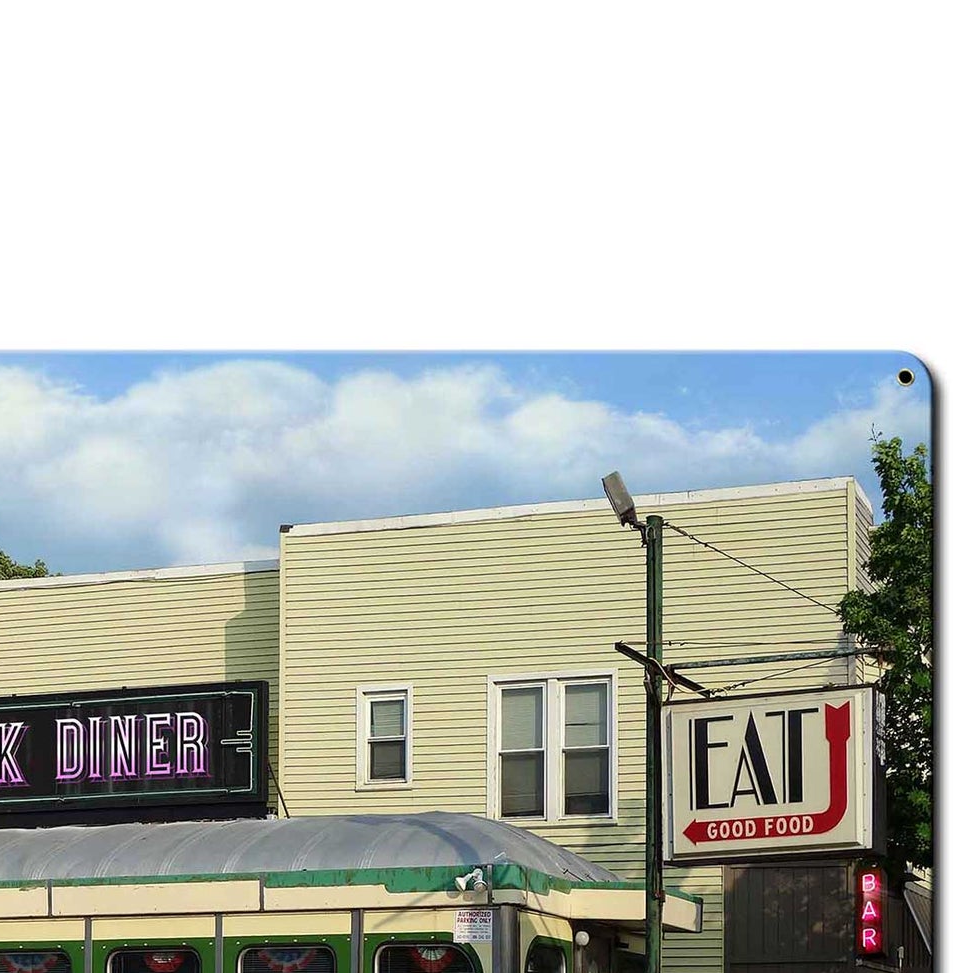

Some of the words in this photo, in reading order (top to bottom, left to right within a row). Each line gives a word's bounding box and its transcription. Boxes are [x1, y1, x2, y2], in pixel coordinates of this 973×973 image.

[55, 711, 211, 784] DINER
[689, 707, 819, 811] EAT
[706, 820, 757, 840] GOOD
[764, 815, 815, 836] FOOD
[861, 873, 877, 948] BAR
